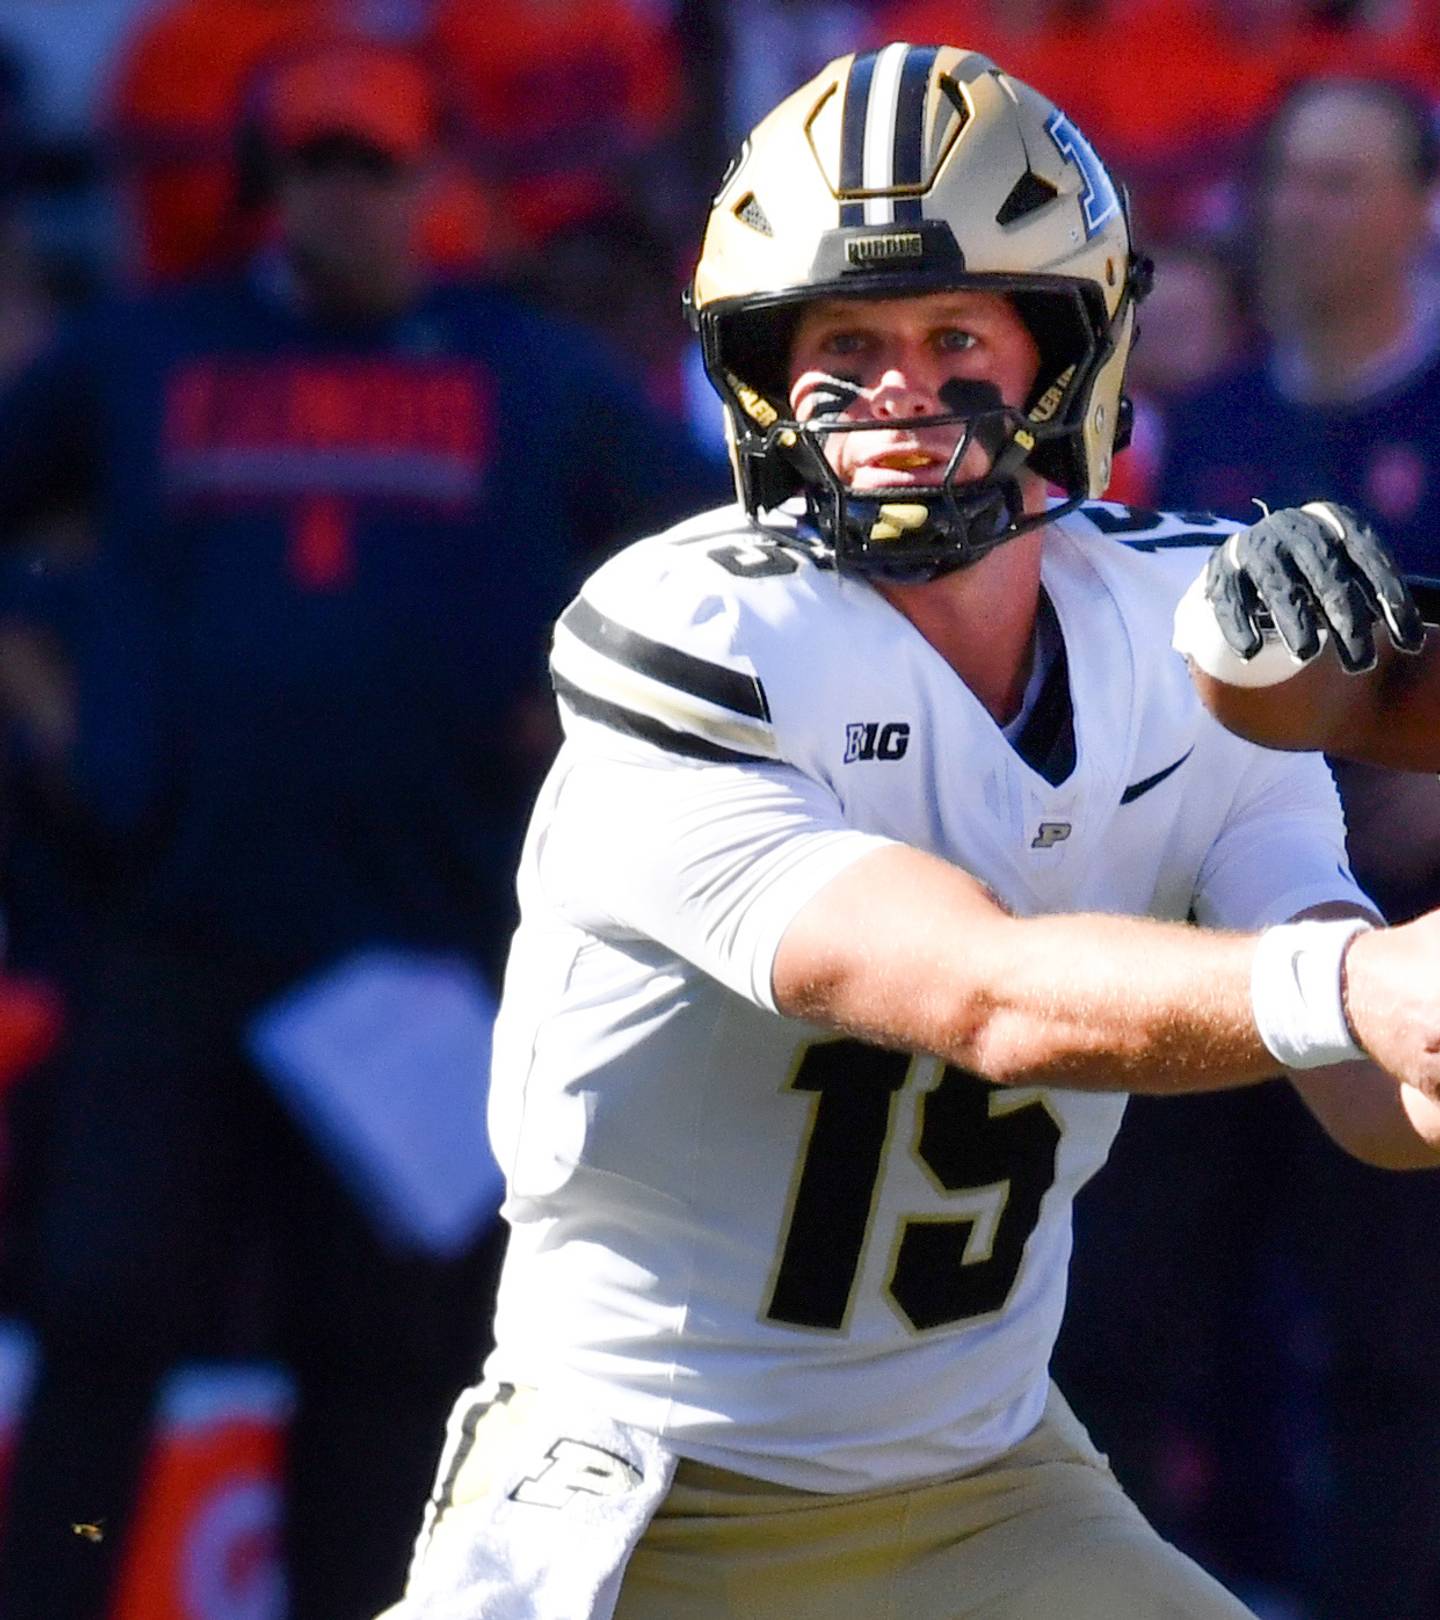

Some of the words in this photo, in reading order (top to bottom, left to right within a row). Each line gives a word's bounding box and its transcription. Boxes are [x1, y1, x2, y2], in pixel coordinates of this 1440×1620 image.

[1031, 822, 1072, 848] P
[757, 1033, 1066, 1339] 15
[508, 1438, 645, 1509] P
